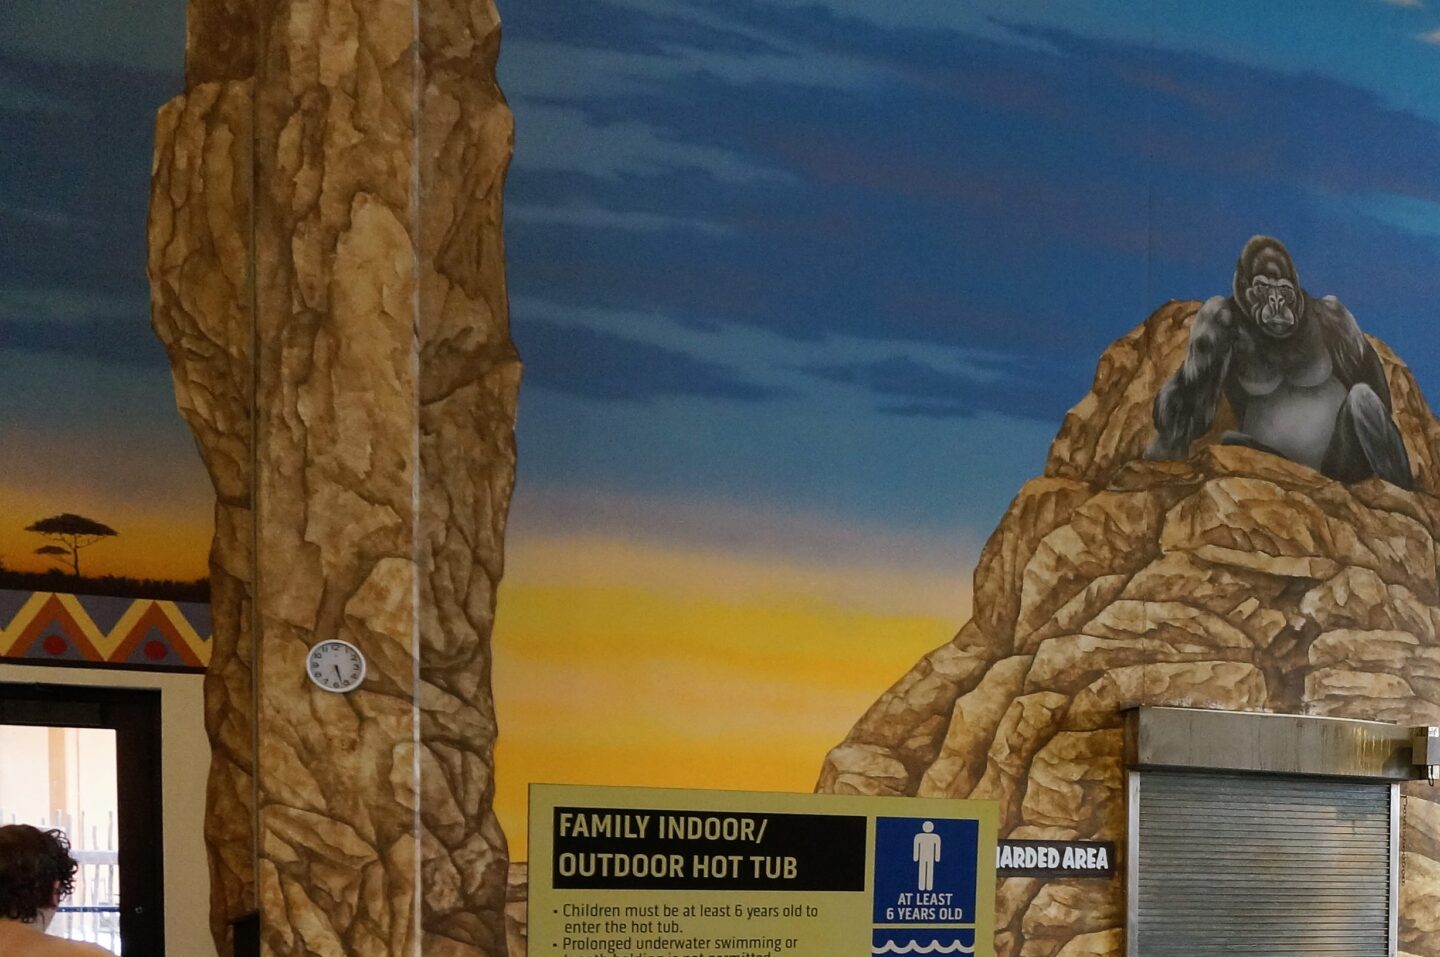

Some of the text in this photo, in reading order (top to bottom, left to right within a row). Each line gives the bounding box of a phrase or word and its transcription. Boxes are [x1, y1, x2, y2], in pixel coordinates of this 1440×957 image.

[560, 813, 768, 844] FAMILY INDOOR/
[559, 853, 797, 879] OUTDOOR HOT TUB
[1062, 846, 1108, 870] AREA
[898, 893, 953, 905] AT LEAST
[563, 903, 818, 920] Children must be at least 6 years old to
[886, 908, 962, 920] 6 YEARS OLD
[564, 920, 683, 934] enter the hot tub.
[563, 936, 798, 954] Prolonged underwater swimming or
